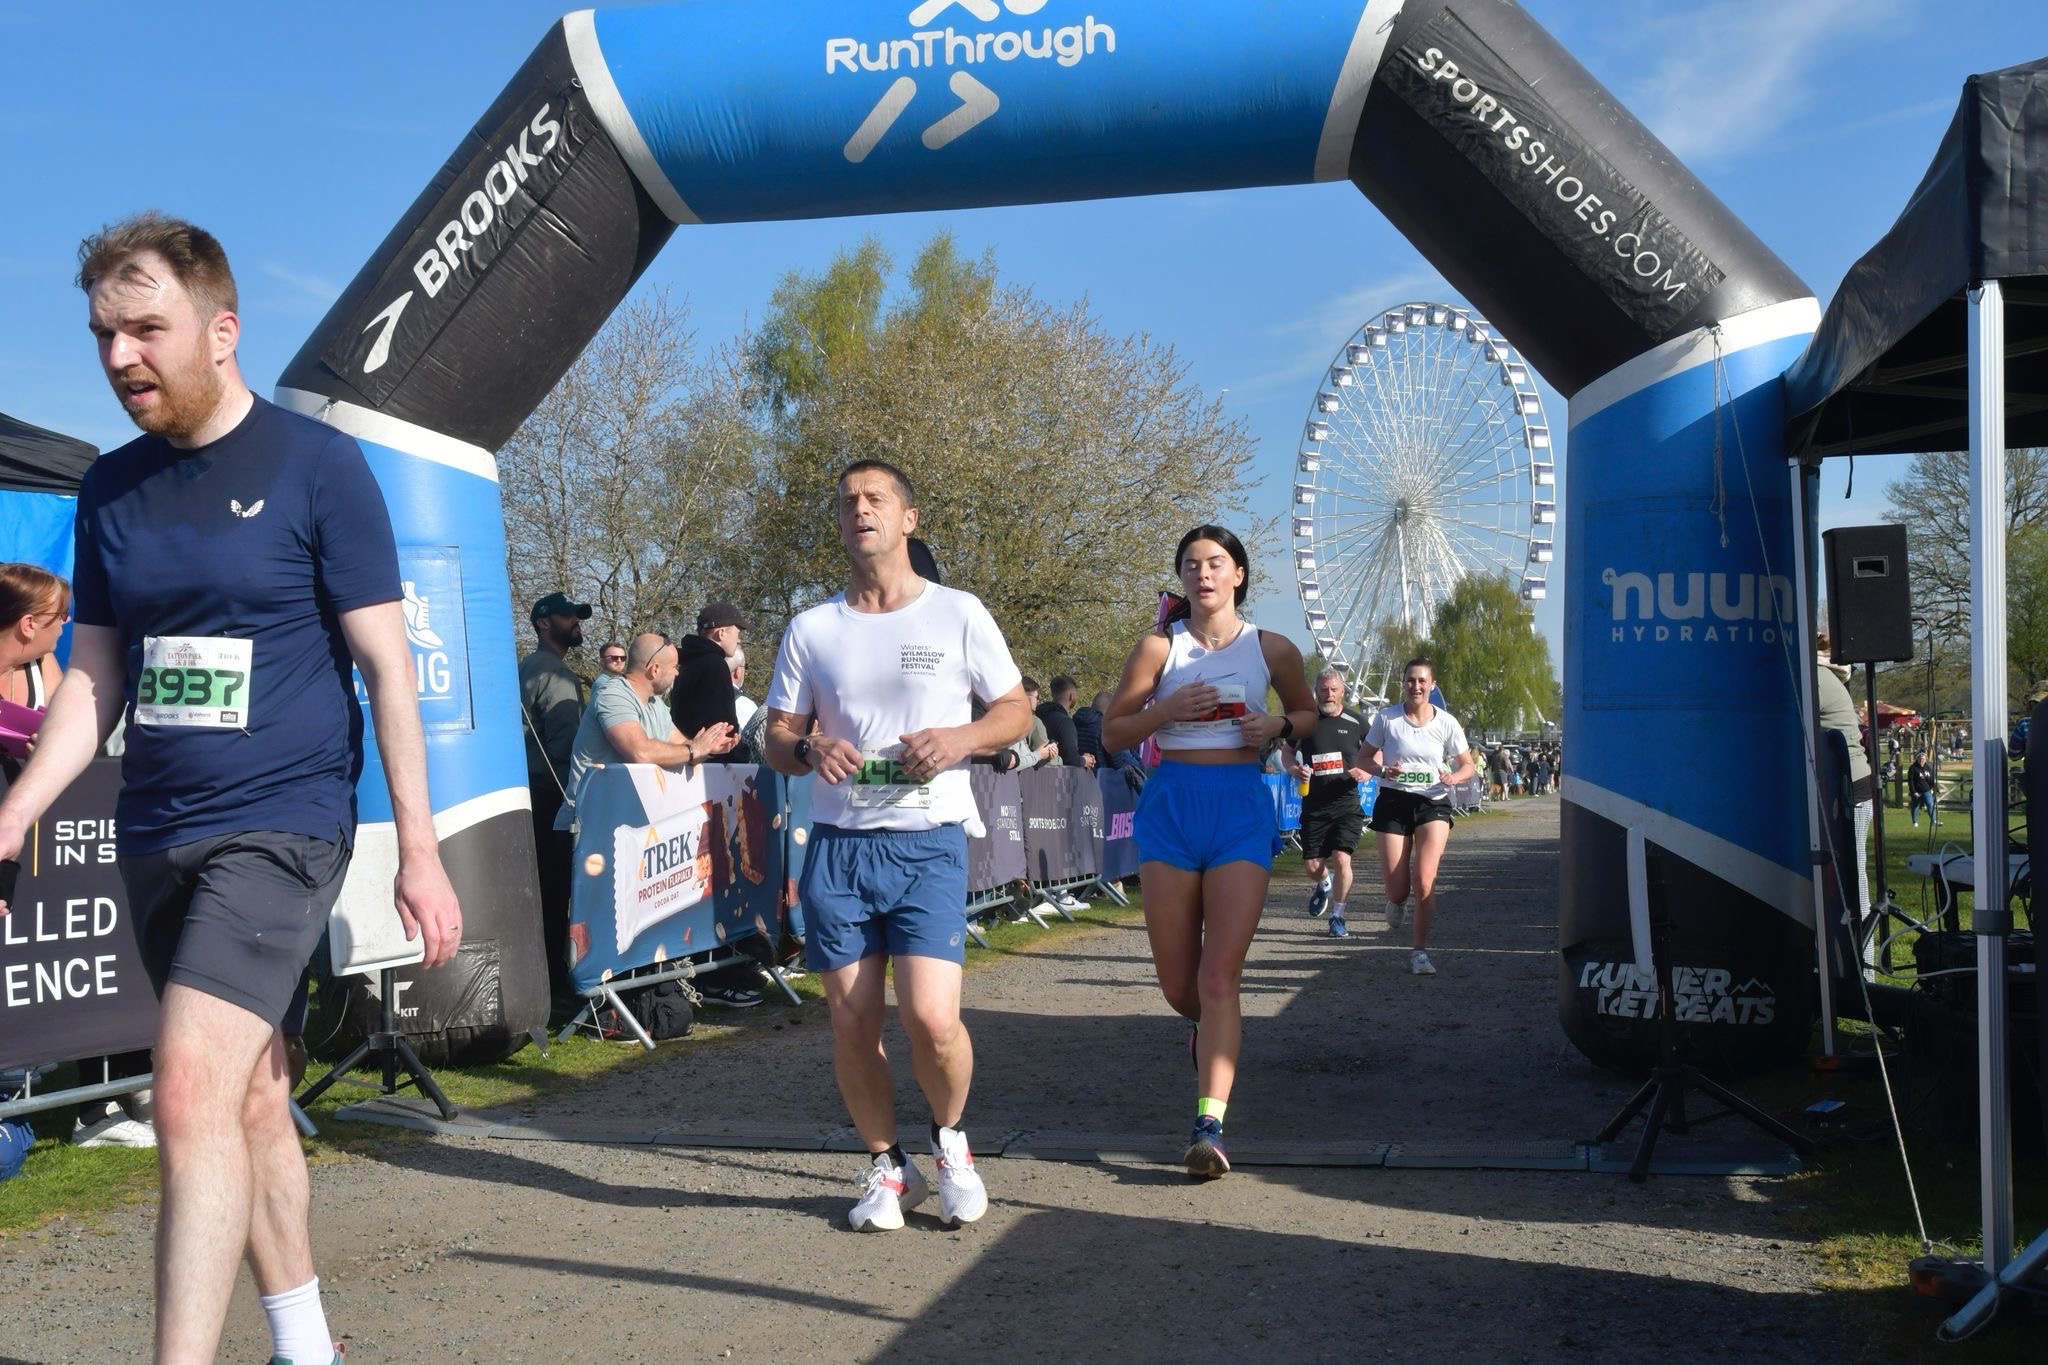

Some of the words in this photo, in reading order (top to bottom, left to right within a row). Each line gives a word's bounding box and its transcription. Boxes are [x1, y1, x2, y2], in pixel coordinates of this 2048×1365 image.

[826, 15, 1116, 74] RunThrough
[1418, 47, 1687, 301] SPORTSSHOES.COM
[413, 103, 560, 298] BROOKS
[1612, 625, 1793, 646] HYDRATION
[900, 650, 945, 658] WILMSLOW
[901, 663, 935, 671] FESTIVAL
[139, 667, 244, 707] 3937
[1399, 772, 1432, 783] 3901
[55, 844, 86, 866] IN
[643, 831, 693, 879] TREK
[638, 879, 668, 903] PROTEIN
[5, 897, 118, 945] LLED
[5, 955, 118, 1007] ENCE
[400, 1007, 420, 1017] KIT
